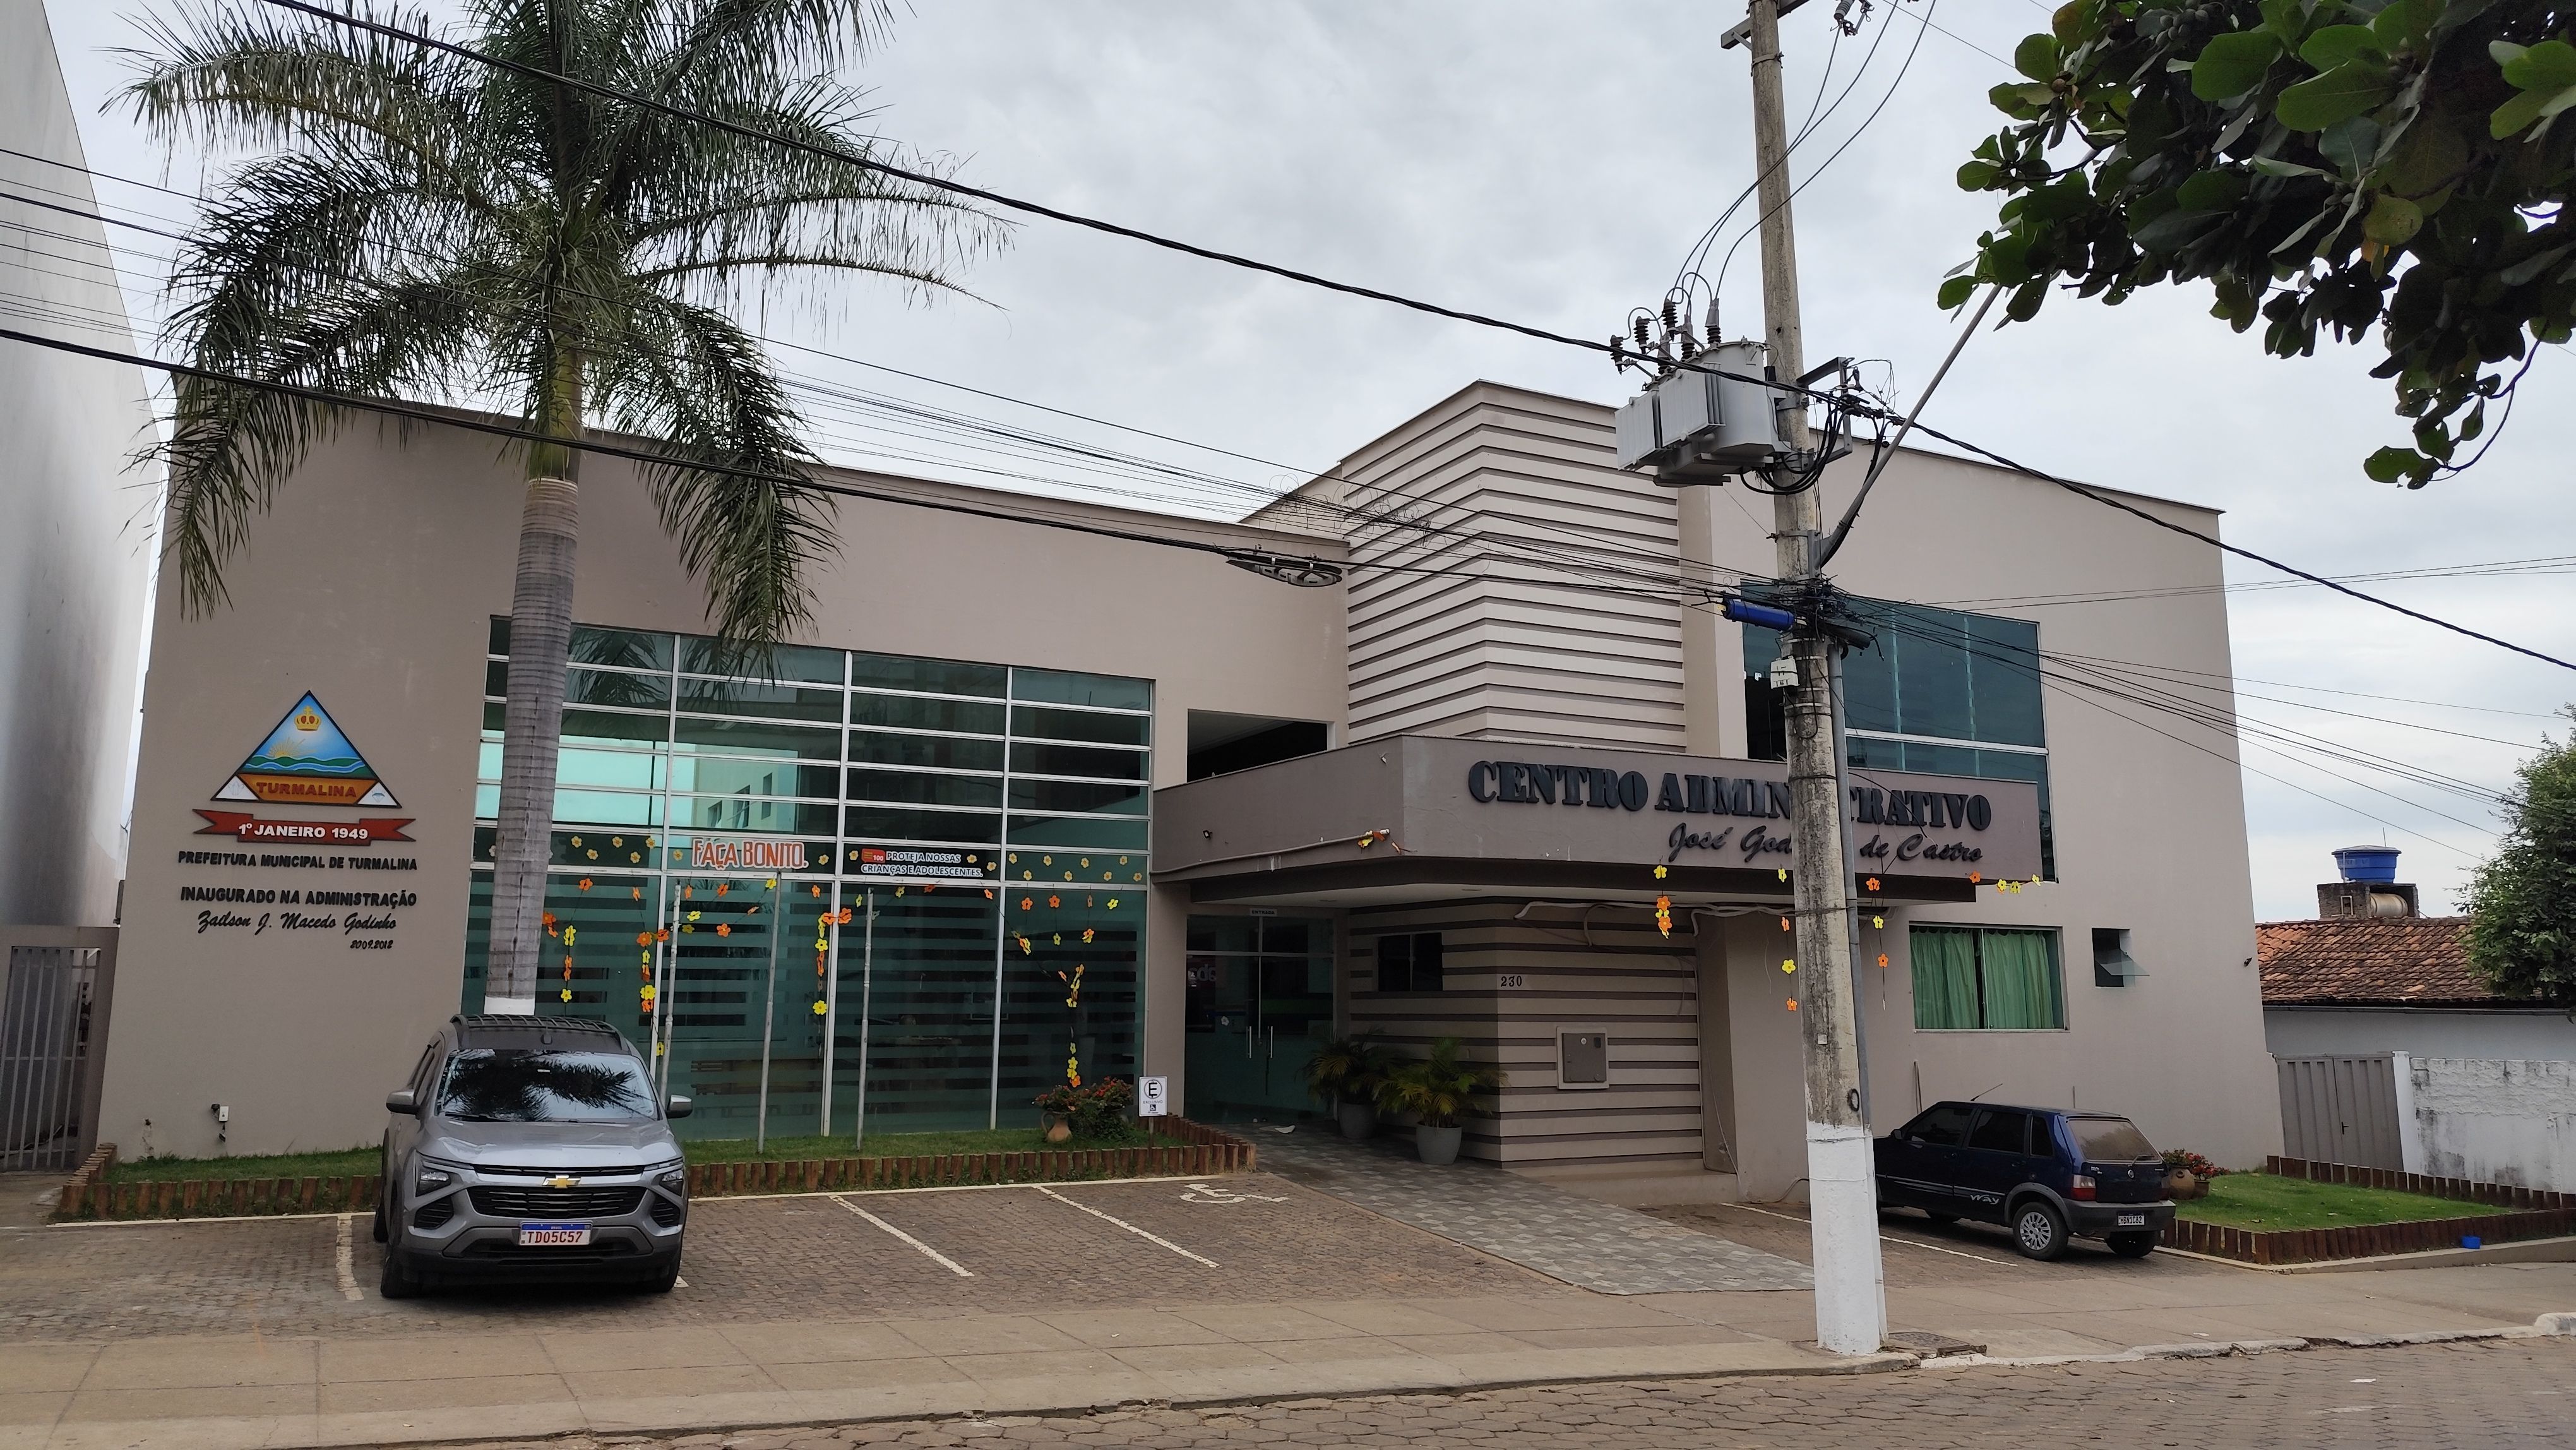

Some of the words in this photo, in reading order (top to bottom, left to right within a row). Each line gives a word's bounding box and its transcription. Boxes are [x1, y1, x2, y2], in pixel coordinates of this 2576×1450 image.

[256, 782, 357, 798] TURMALINA
[1468, 760, 1649, 811] CENTRO
[1655, 773, 1992, 831] ADMINRATIVO
[254, 825, 326, 838] JANEIRO
[331, 828, 368, 839] 1949
[1668, 822, 1734, 863] José
[1859, 834, 1890, 858] de
[1897, 834, 1983, 862] Castro
[178, 851, 256, 866] PREFEITURA
[261, 854, 325, 868] MUNICIPAL
[329, 857, 344, 869] DE
[349, 857, 417, 870] TURMALINA
[693, 839, 739, 869] FAÇA
[742, 841, 808, 868] BONITO.
[886, 851, 924, 863] PROTEJA
[926, 853, 961, 863] NOSSAS
[861, 865, 906, 875] CRIANÇAS
[915, 866, 984, 877] ADOLESCENTES.
[181, 887, 276, 904] INAUGURADO
[280, 890, 300, 904] NA
[305, 890, 417, 909] ADMINISTRAÇÃO
[280, 912, 337, 930] Macedo
[344, 912, 397, 935] Godinho
[1500, 975, 1522, 987] 230
